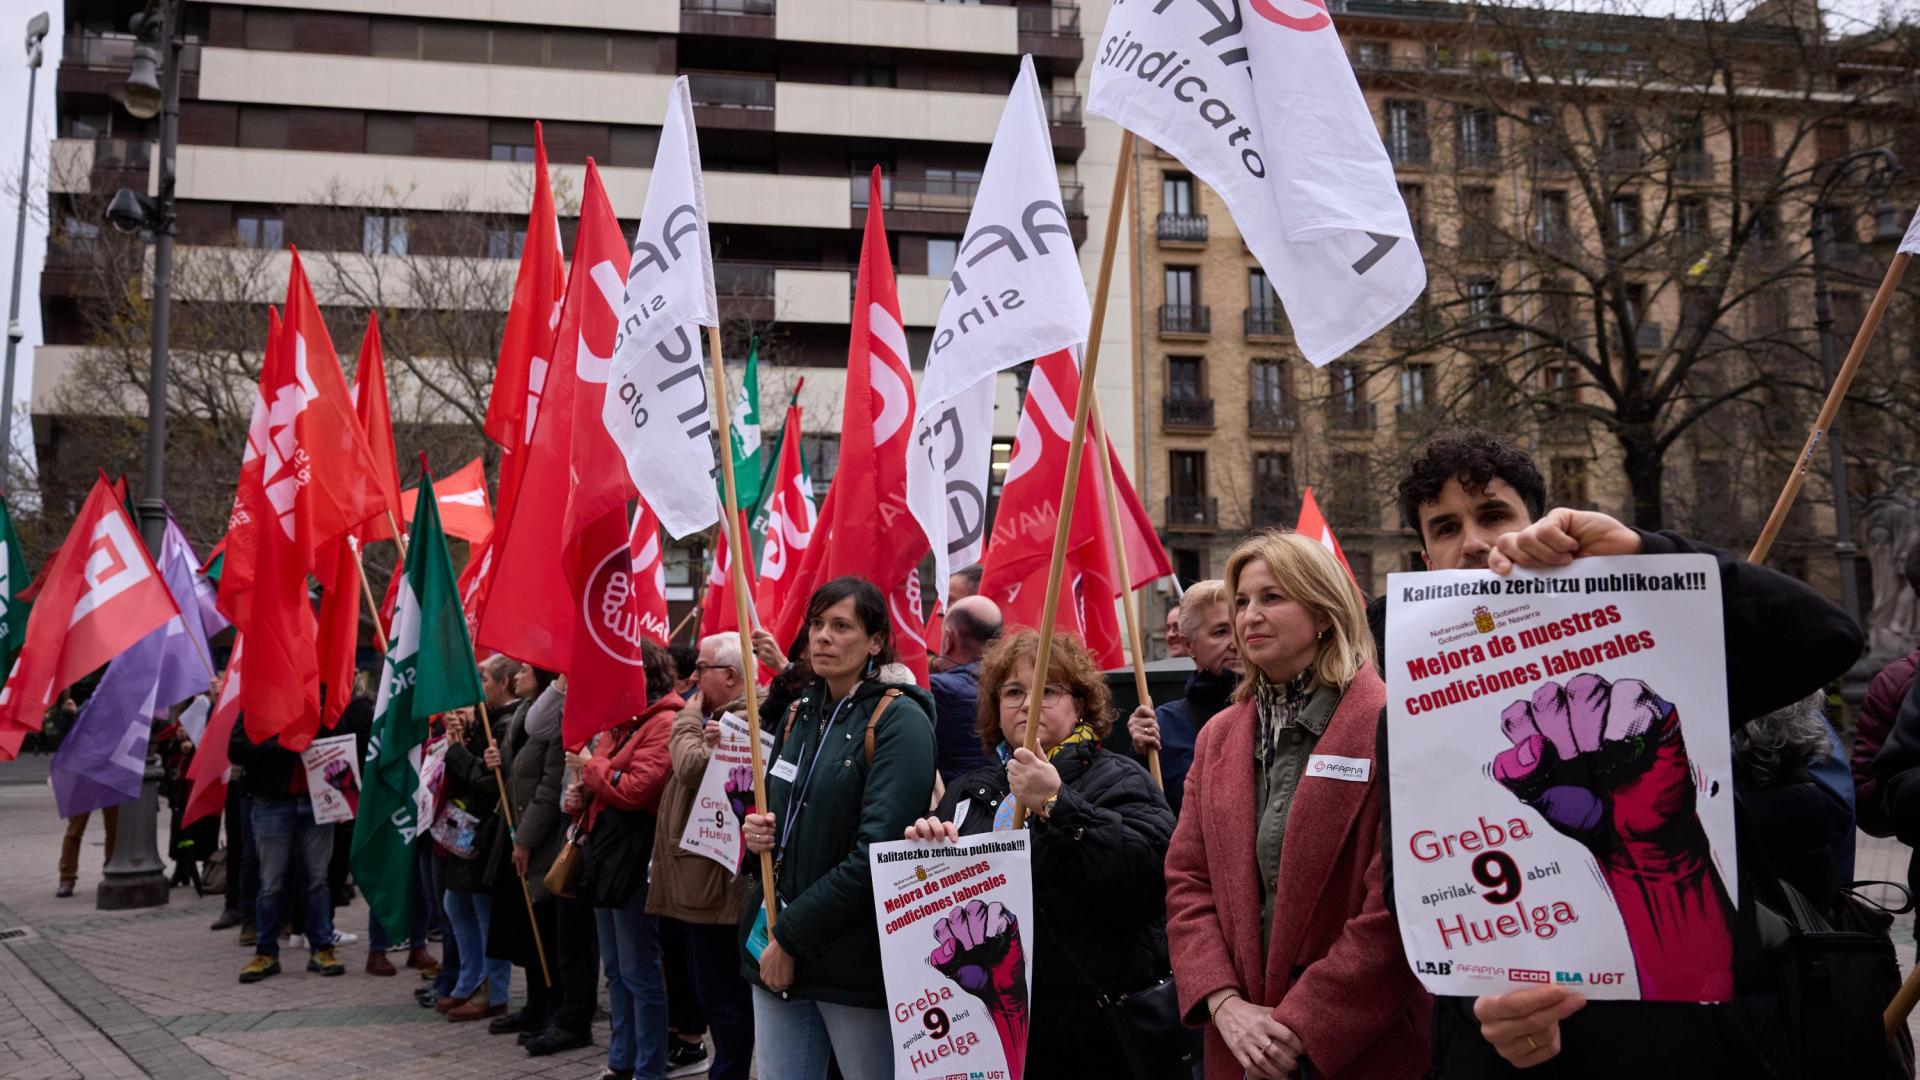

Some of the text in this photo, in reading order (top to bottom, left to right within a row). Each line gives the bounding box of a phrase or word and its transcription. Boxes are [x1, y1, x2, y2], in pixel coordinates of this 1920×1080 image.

[1100, 30, 1266, 179] sindicato
[1402, 572, 1707, 602] Kalitatezko zerbitzu publikoak!!!
[1430, 603, 1530, 638] Nafarroako Gobierno
[1438, 609, 1541, 645] Gobernua de Navarra
[1406, 604, 1622, 681] Mejora de nuestras
[1405, 630, 1655, 716] condiciones laborales
[715, 810, 724, 828] 9
[1409, 816, 1533, 862] Greba
[877, 840, 1025, 863] Kalitatezko zerbitzu publikoak!!!
[884, 888, 924, 914] Mejora
[924, 881, 939, 895] de
[940, 861, 990, 889] nuestras
[1421, 861, 1561, 906] apirilak abril
[1471, 850, 1522, 905] 9
[885, 895, 953, 934] condiciones
[952, 874, 1006, 903] laborales
[1436, 900, 1578, 950] Huelga
[1510, 970, 1549, 983] CCOO
[1555, 971, 1583, 983] ELA
[1589, 972, 1625, 985] UGT
[895, 986, 954, 1023] Greba
[923, 1007, 950, 1040] 9
[902, 1009, 970, 1049] apirilak abril
[910, 1032, 980, 1074] Huelga
[987, 1071, 1004, 1080] UGT
